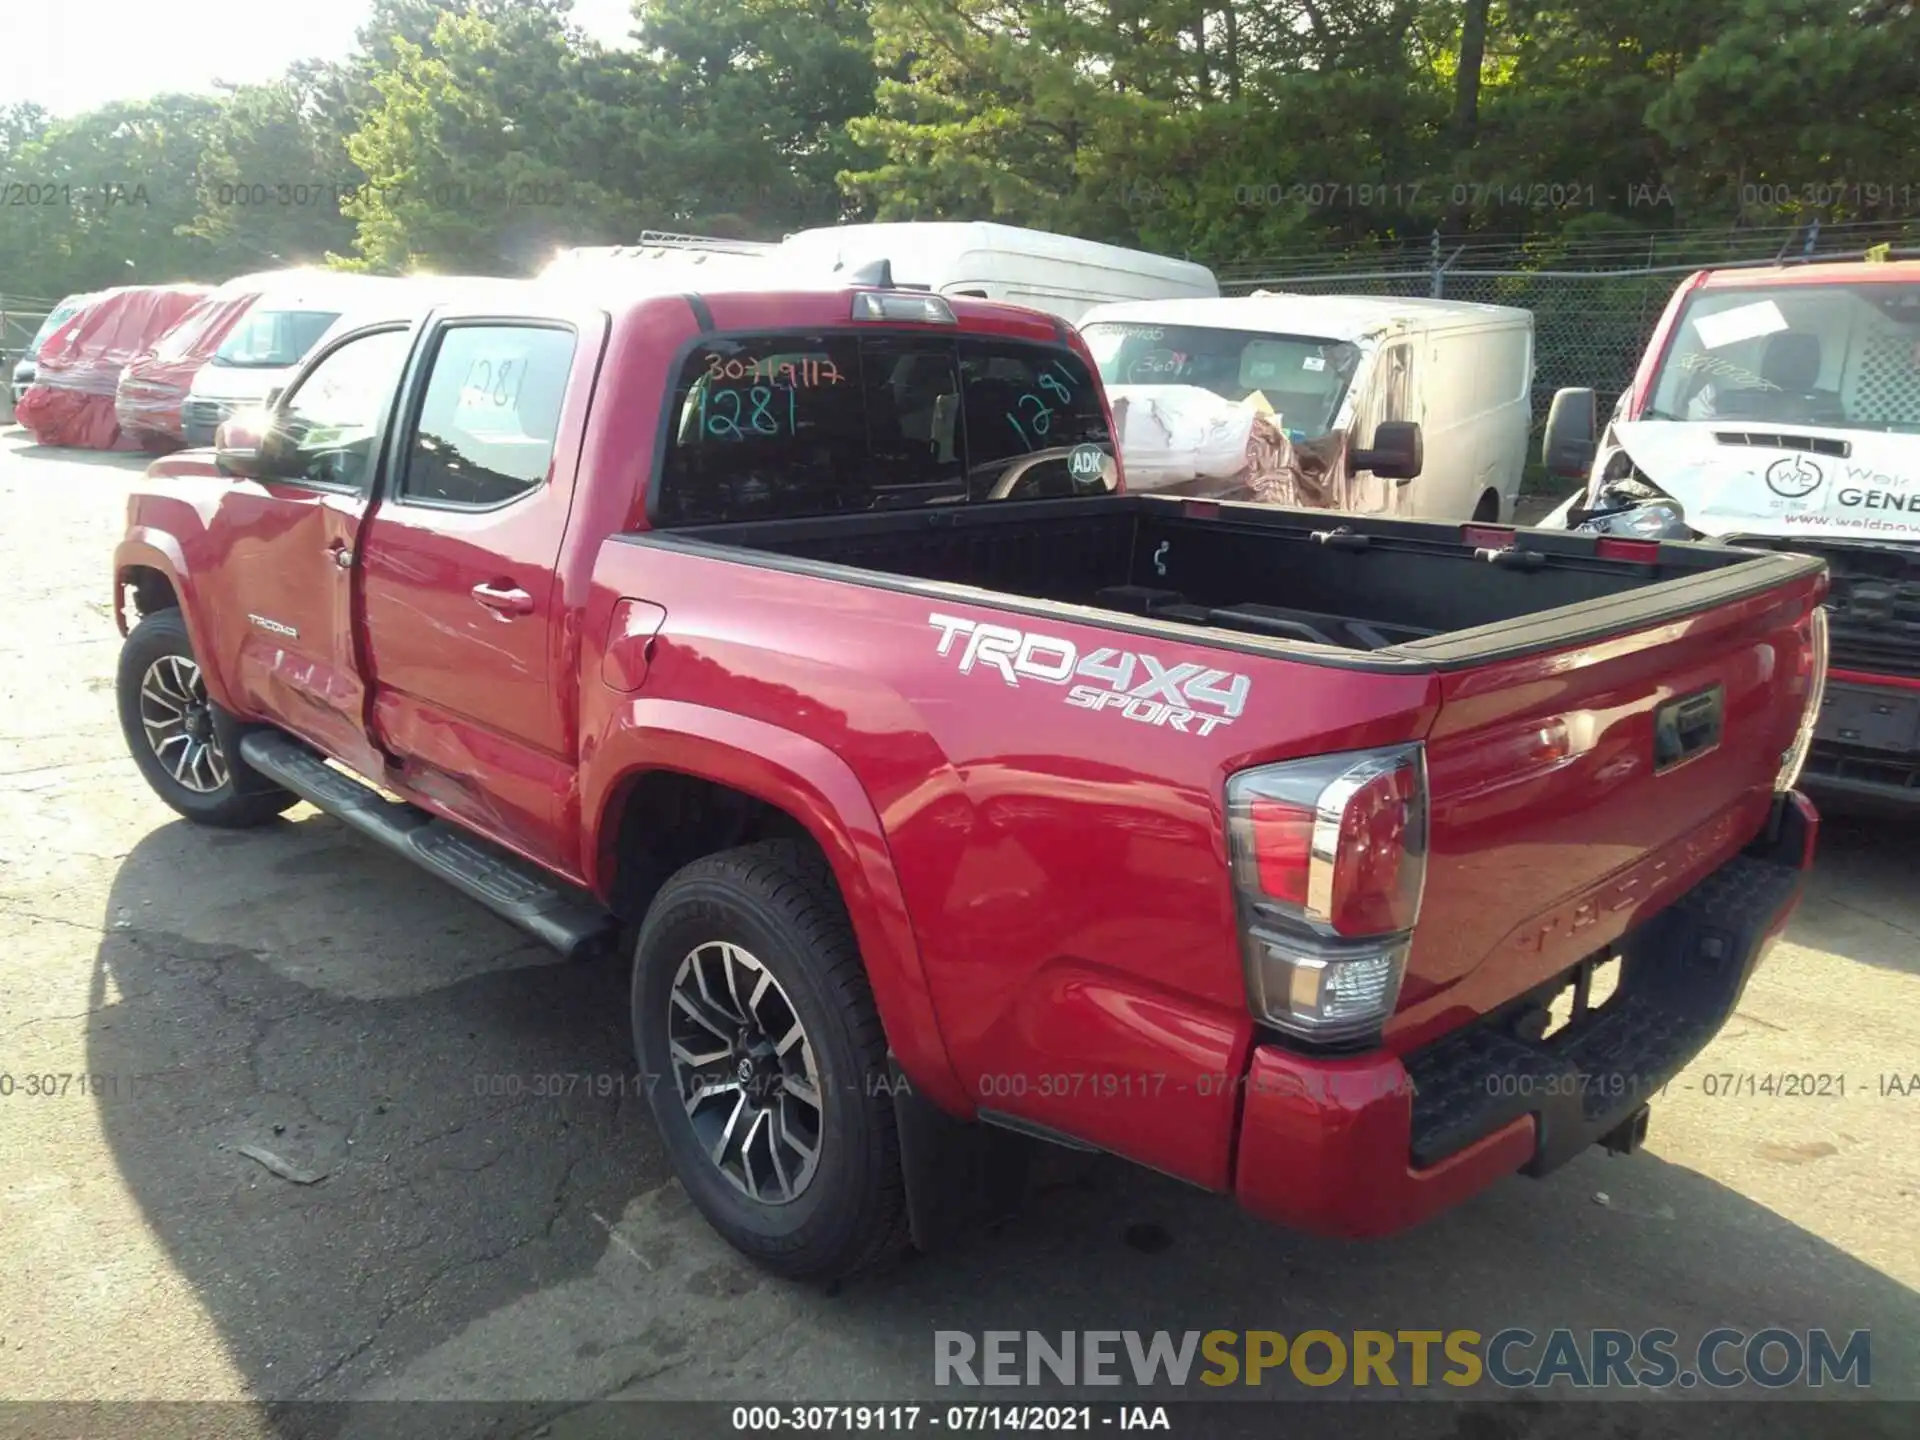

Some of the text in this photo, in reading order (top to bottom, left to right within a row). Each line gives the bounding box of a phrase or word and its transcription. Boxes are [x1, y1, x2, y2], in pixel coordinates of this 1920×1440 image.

[456, 358, 529, 412] 1281
[1006, 360, 1080, 452] 1281
[698, 384, 796, 443] 1281
[1073, 451, 1102, 474] ADK
[928, 612, 1078, 688] TRD
[1064, 684, 1237, 737] SPORT
